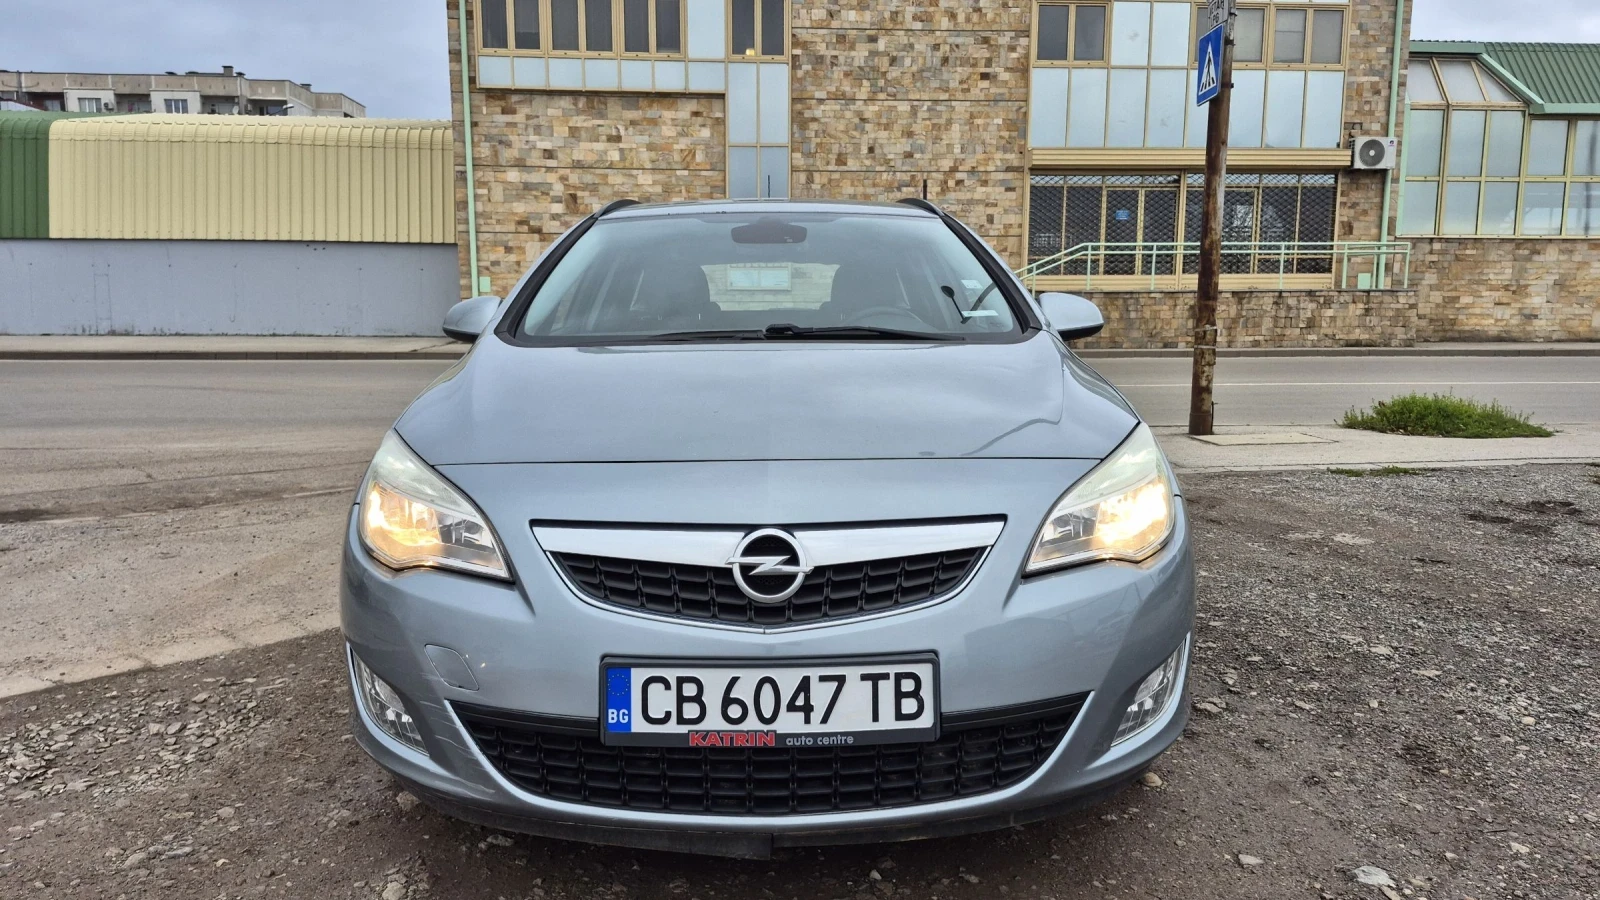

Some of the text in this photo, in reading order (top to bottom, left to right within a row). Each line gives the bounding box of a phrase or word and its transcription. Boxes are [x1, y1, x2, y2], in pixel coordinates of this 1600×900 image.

[641, 672, 925, 726] CB 6047 TB
[608, 709, 629, 724] BG
[689, 731, 854, 747] KATRIN auto centre
